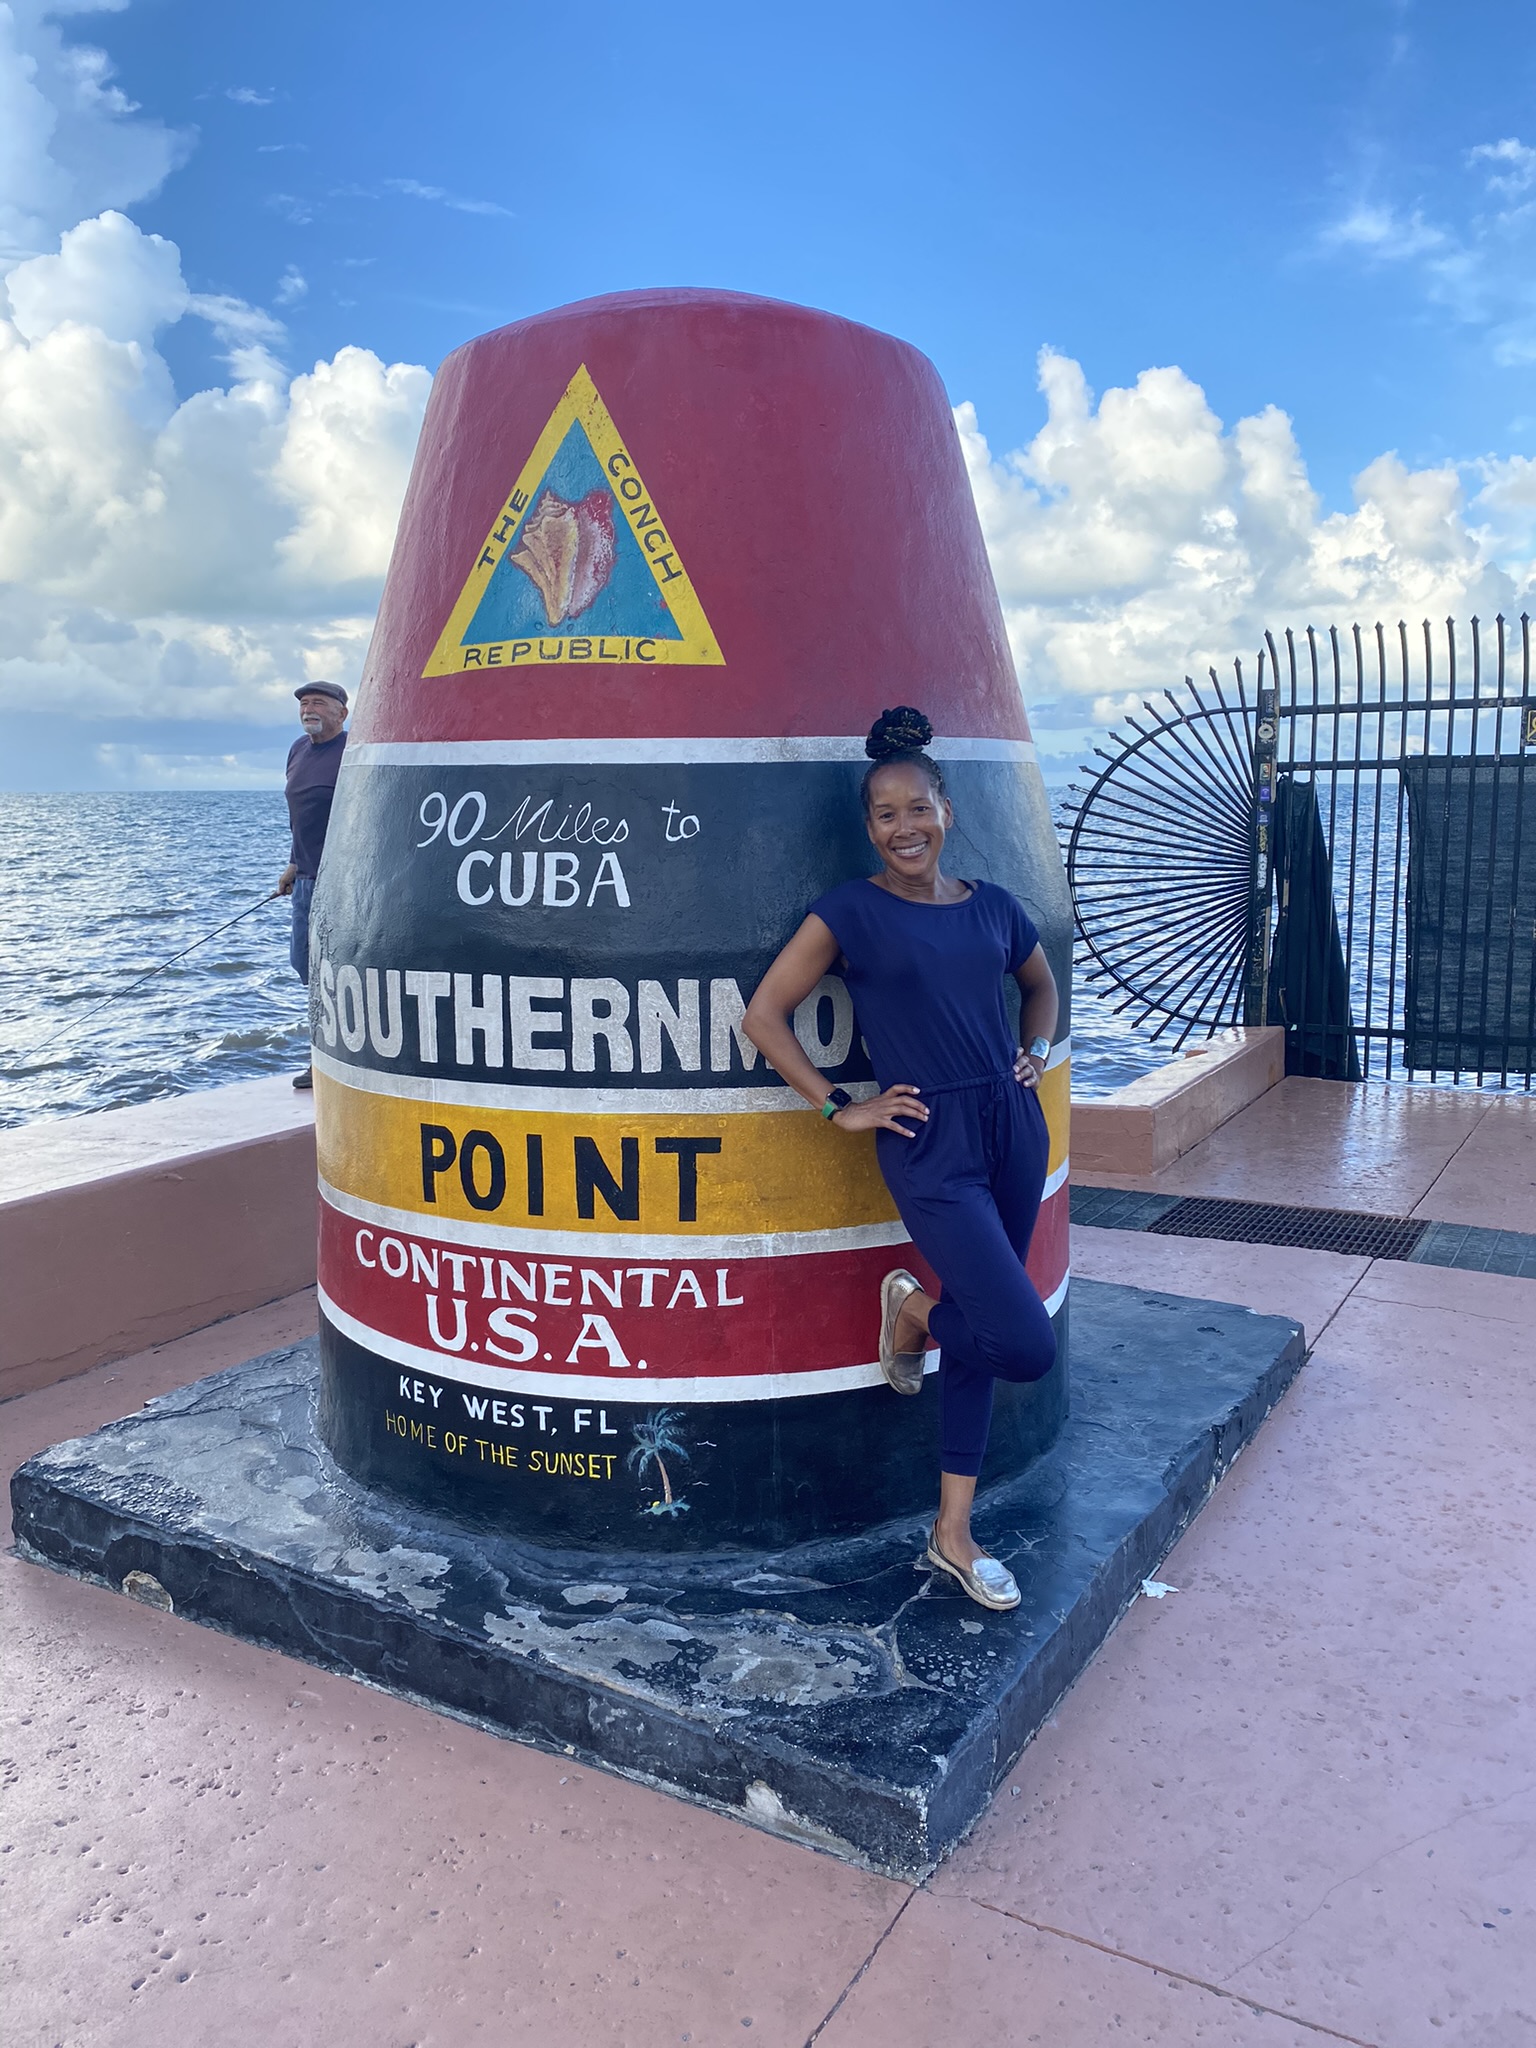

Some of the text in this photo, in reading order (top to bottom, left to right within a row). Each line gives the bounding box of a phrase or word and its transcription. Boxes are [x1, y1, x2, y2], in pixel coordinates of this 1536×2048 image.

[477, 489, 529, 571] THE
[607, 453, 682, 583] CONCH
[463, 638, 656, 668] REPUBLIC
[417, 791, 701, 848] 90 Miles to
[456, 850, 632, 908] CUBA
[320, 958, 871, 1072] SOUTHERNMO
[420, 1123, 722, 1222] POINT
[355, 1229, 744, 1309] CONTINENTAL
[426, 1294, 648, 1369] U.S.A.
[399, 1375, 618, 1436] KEY WEST, FL
[385, 1409, 617, 1480] HOME OF THE SUNSET
